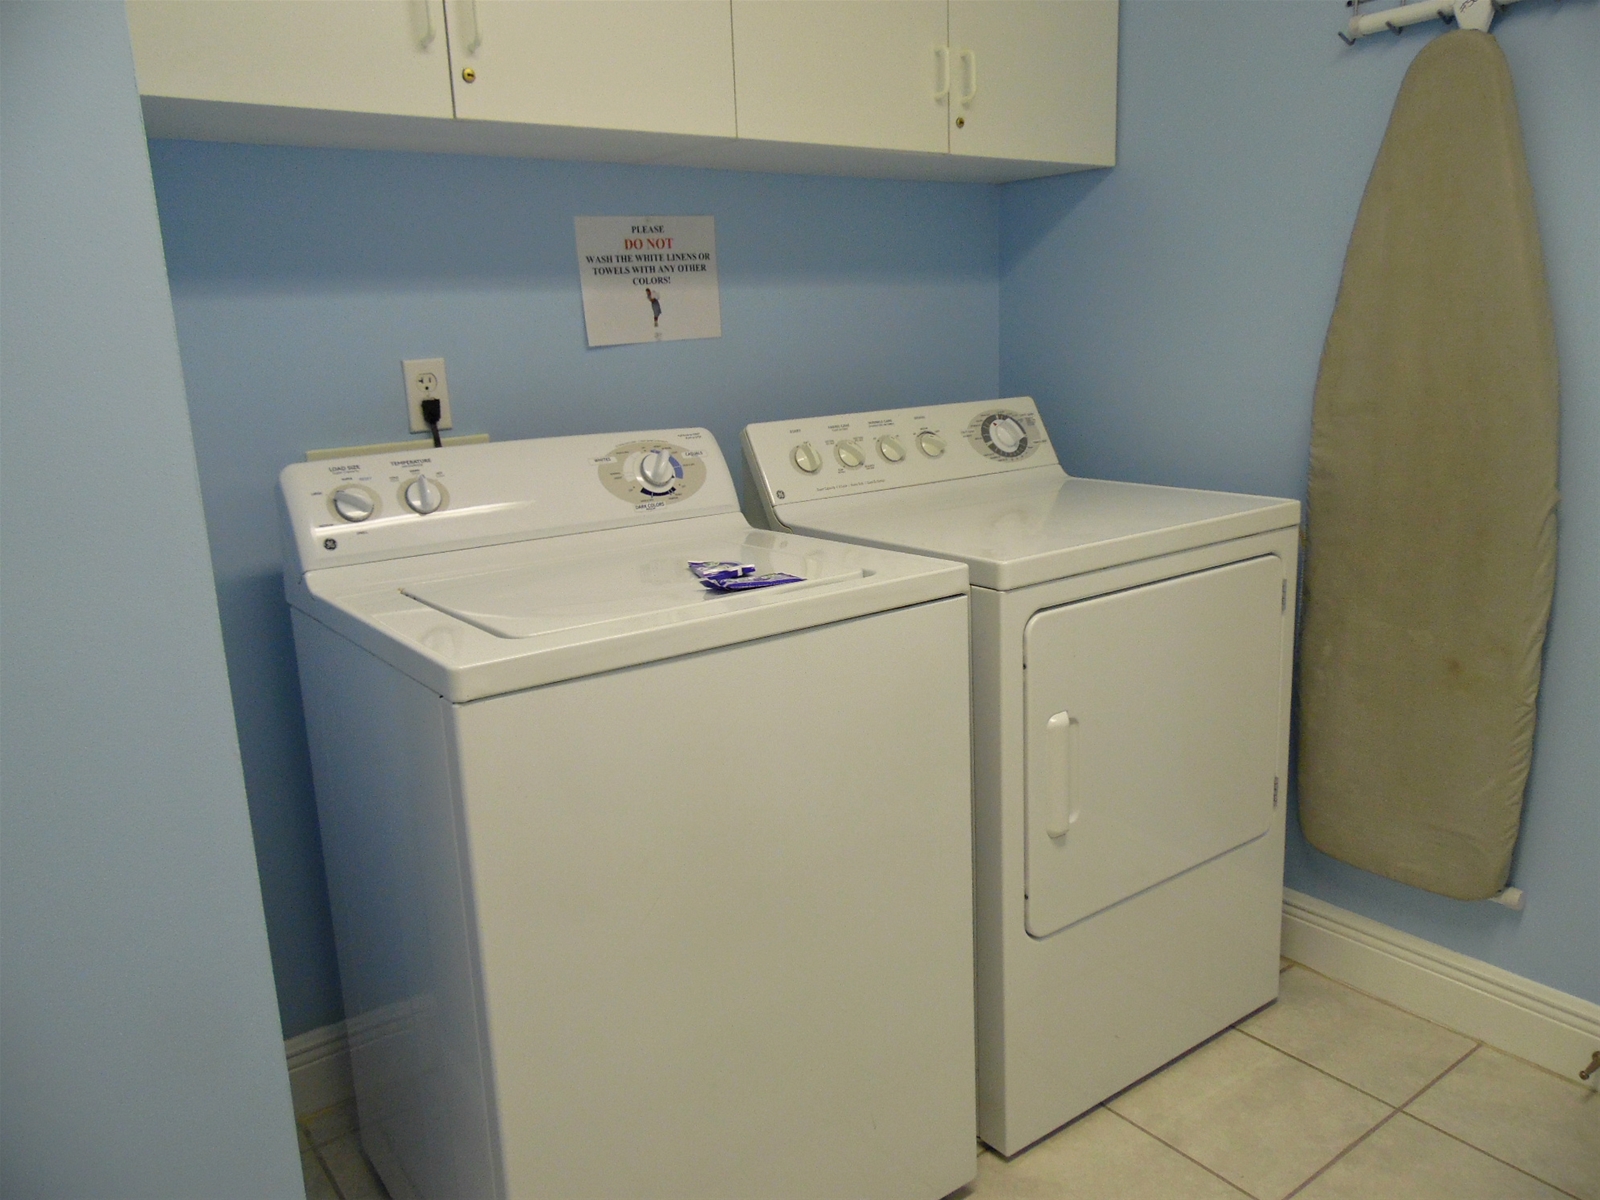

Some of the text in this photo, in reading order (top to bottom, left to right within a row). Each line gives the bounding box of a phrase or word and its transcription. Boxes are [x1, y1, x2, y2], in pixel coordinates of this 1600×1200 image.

[631, 225, 665, 234] PLEASE
[624, 237, 674, 250] DO NOT
[586, 252, 711, 264] WASH THE WHITE LINENS OR
[592, 263, 707, 276] TOWELS WITH ANY OTHER
[632, 276, 671, 286] COLORS!
[390, 458, 431, 466] TEMPERATURE
